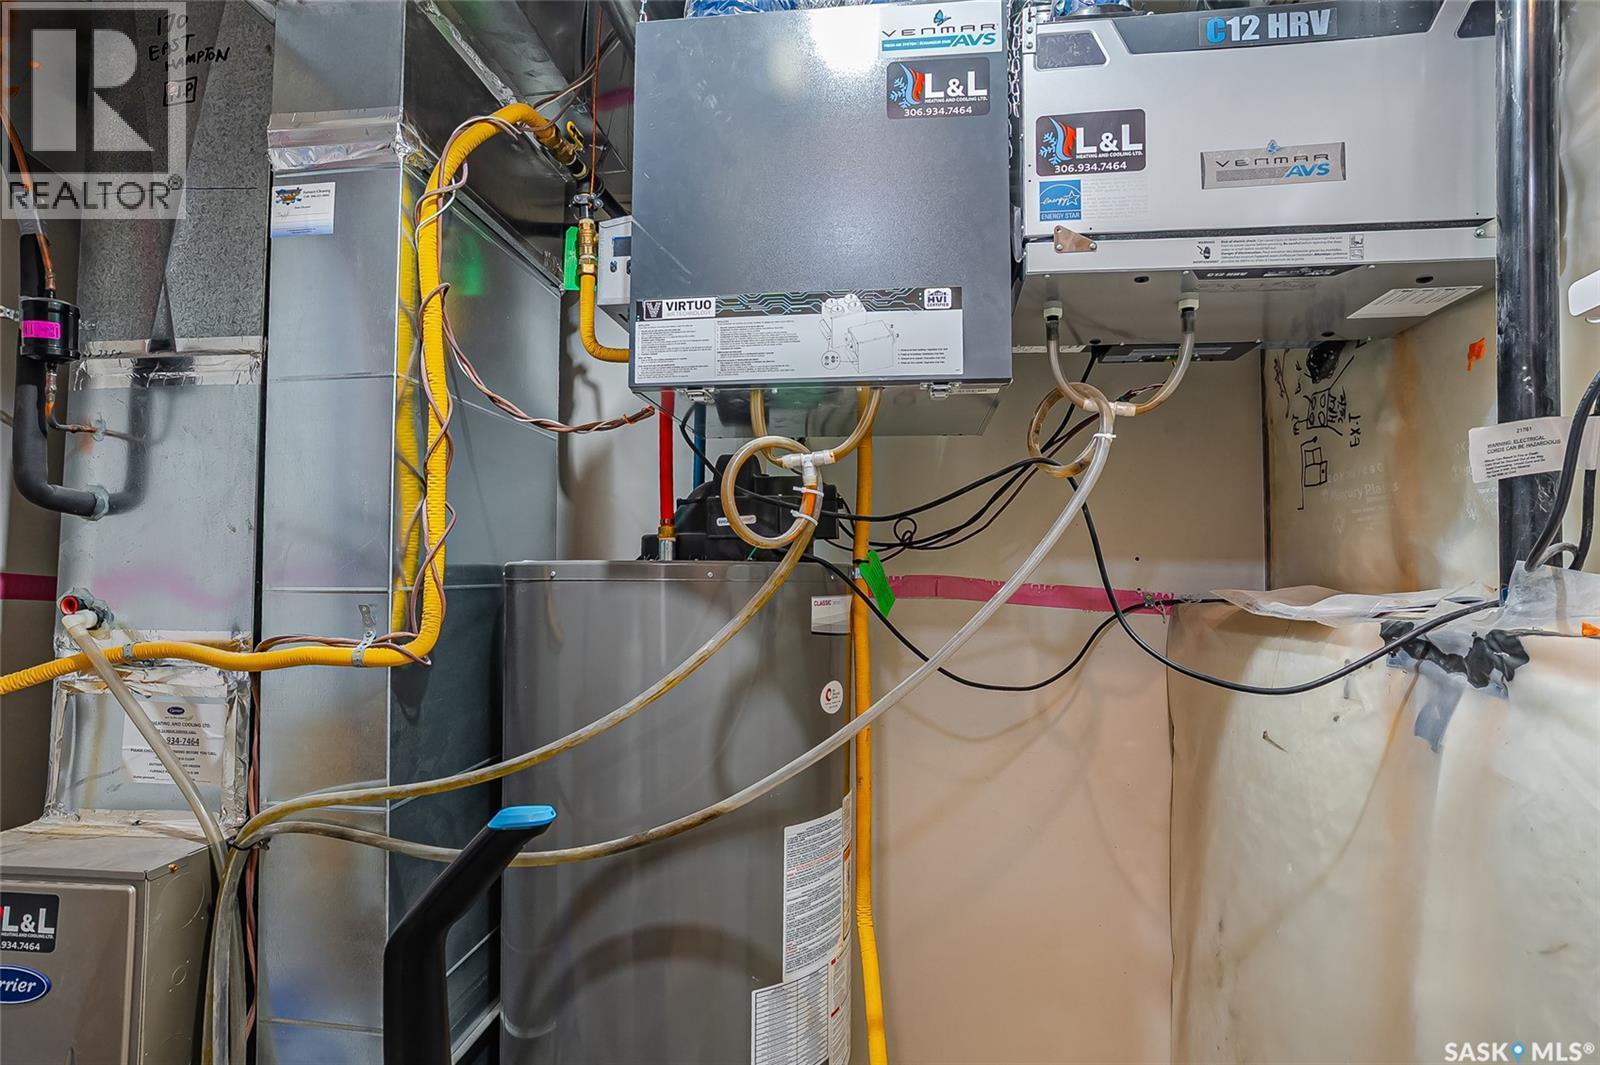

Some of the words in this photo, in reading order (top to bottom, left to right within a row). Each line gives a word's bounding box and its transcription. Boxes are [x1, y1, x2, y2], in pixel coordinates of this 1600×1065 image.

[882, 24, 998, 37] VENMAR
[1206, 15, 1260, 44] C12
[1268, 9, 1331, 39] HRV
[149, 34, 195, 61] EAST
[952, 33, 996, 48] AVS
[165, 47, 230, 72] HAMPTON
[925, 71, 988, 99] L&L
[904, 106, 973, 117] 306.934.7464
[1076, 124, 1143, 153] L&L
[1054, 161, 1127, 174] 306.934.7464
[1215, 154, 1330, 168] VENMAR
[1285, 163, 1331, 178] AVS
[1041, 212, 1064, 220] ENERGY
[1064, 211, 1080, 219] STAR
[666, 300, 712, 312] VIRTUO
[928, 295, 947, 304] HVI
[1, 906, 55, 934] L&L
